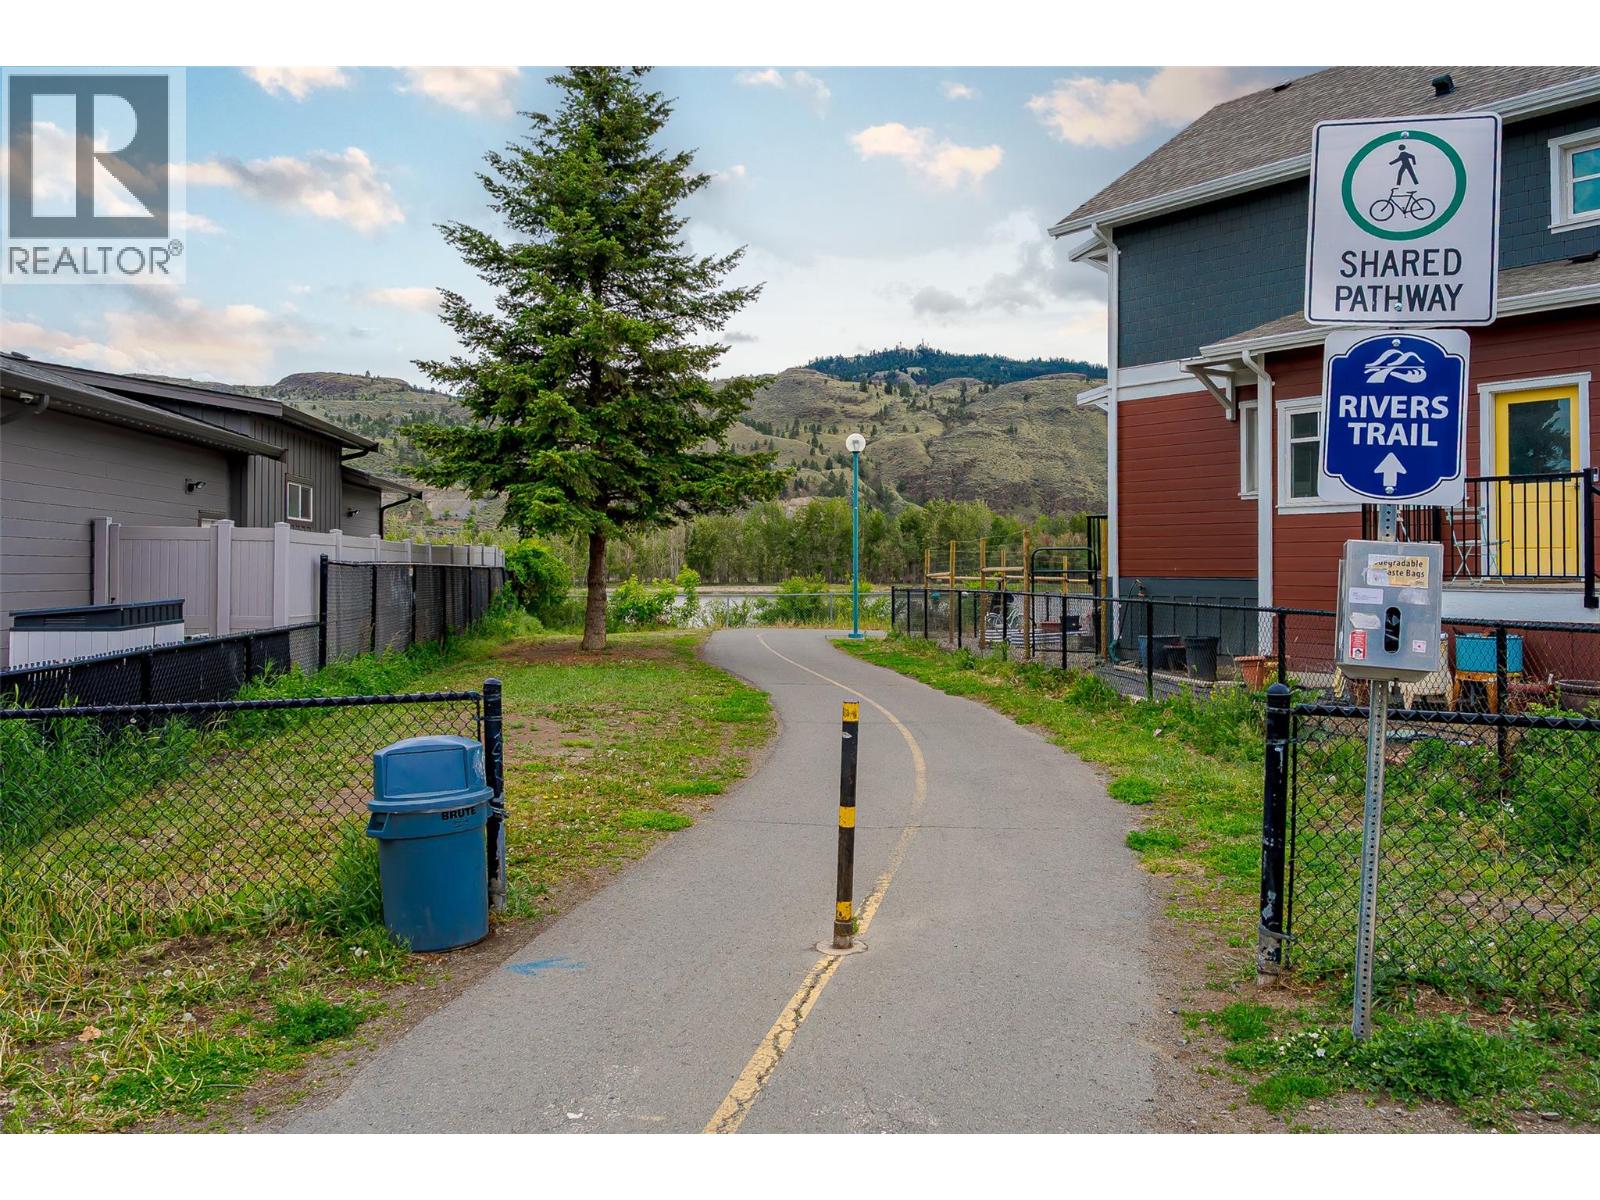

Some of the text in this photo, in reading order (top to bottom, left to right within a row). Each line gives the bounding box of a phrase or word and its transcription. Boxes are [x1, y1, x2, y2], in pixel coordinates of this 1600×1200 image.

[1339, 248, 1463, 278] SHARED
[1334, 283, 1464, 313] PATHWAY
[1338, 394, 1450, 420] RIVERS
[1347, 421, 1439, 447] TRAIL
[1386, 569, 1425, 579] aste Bags
[441, 806, 477, 821] BRUTE
